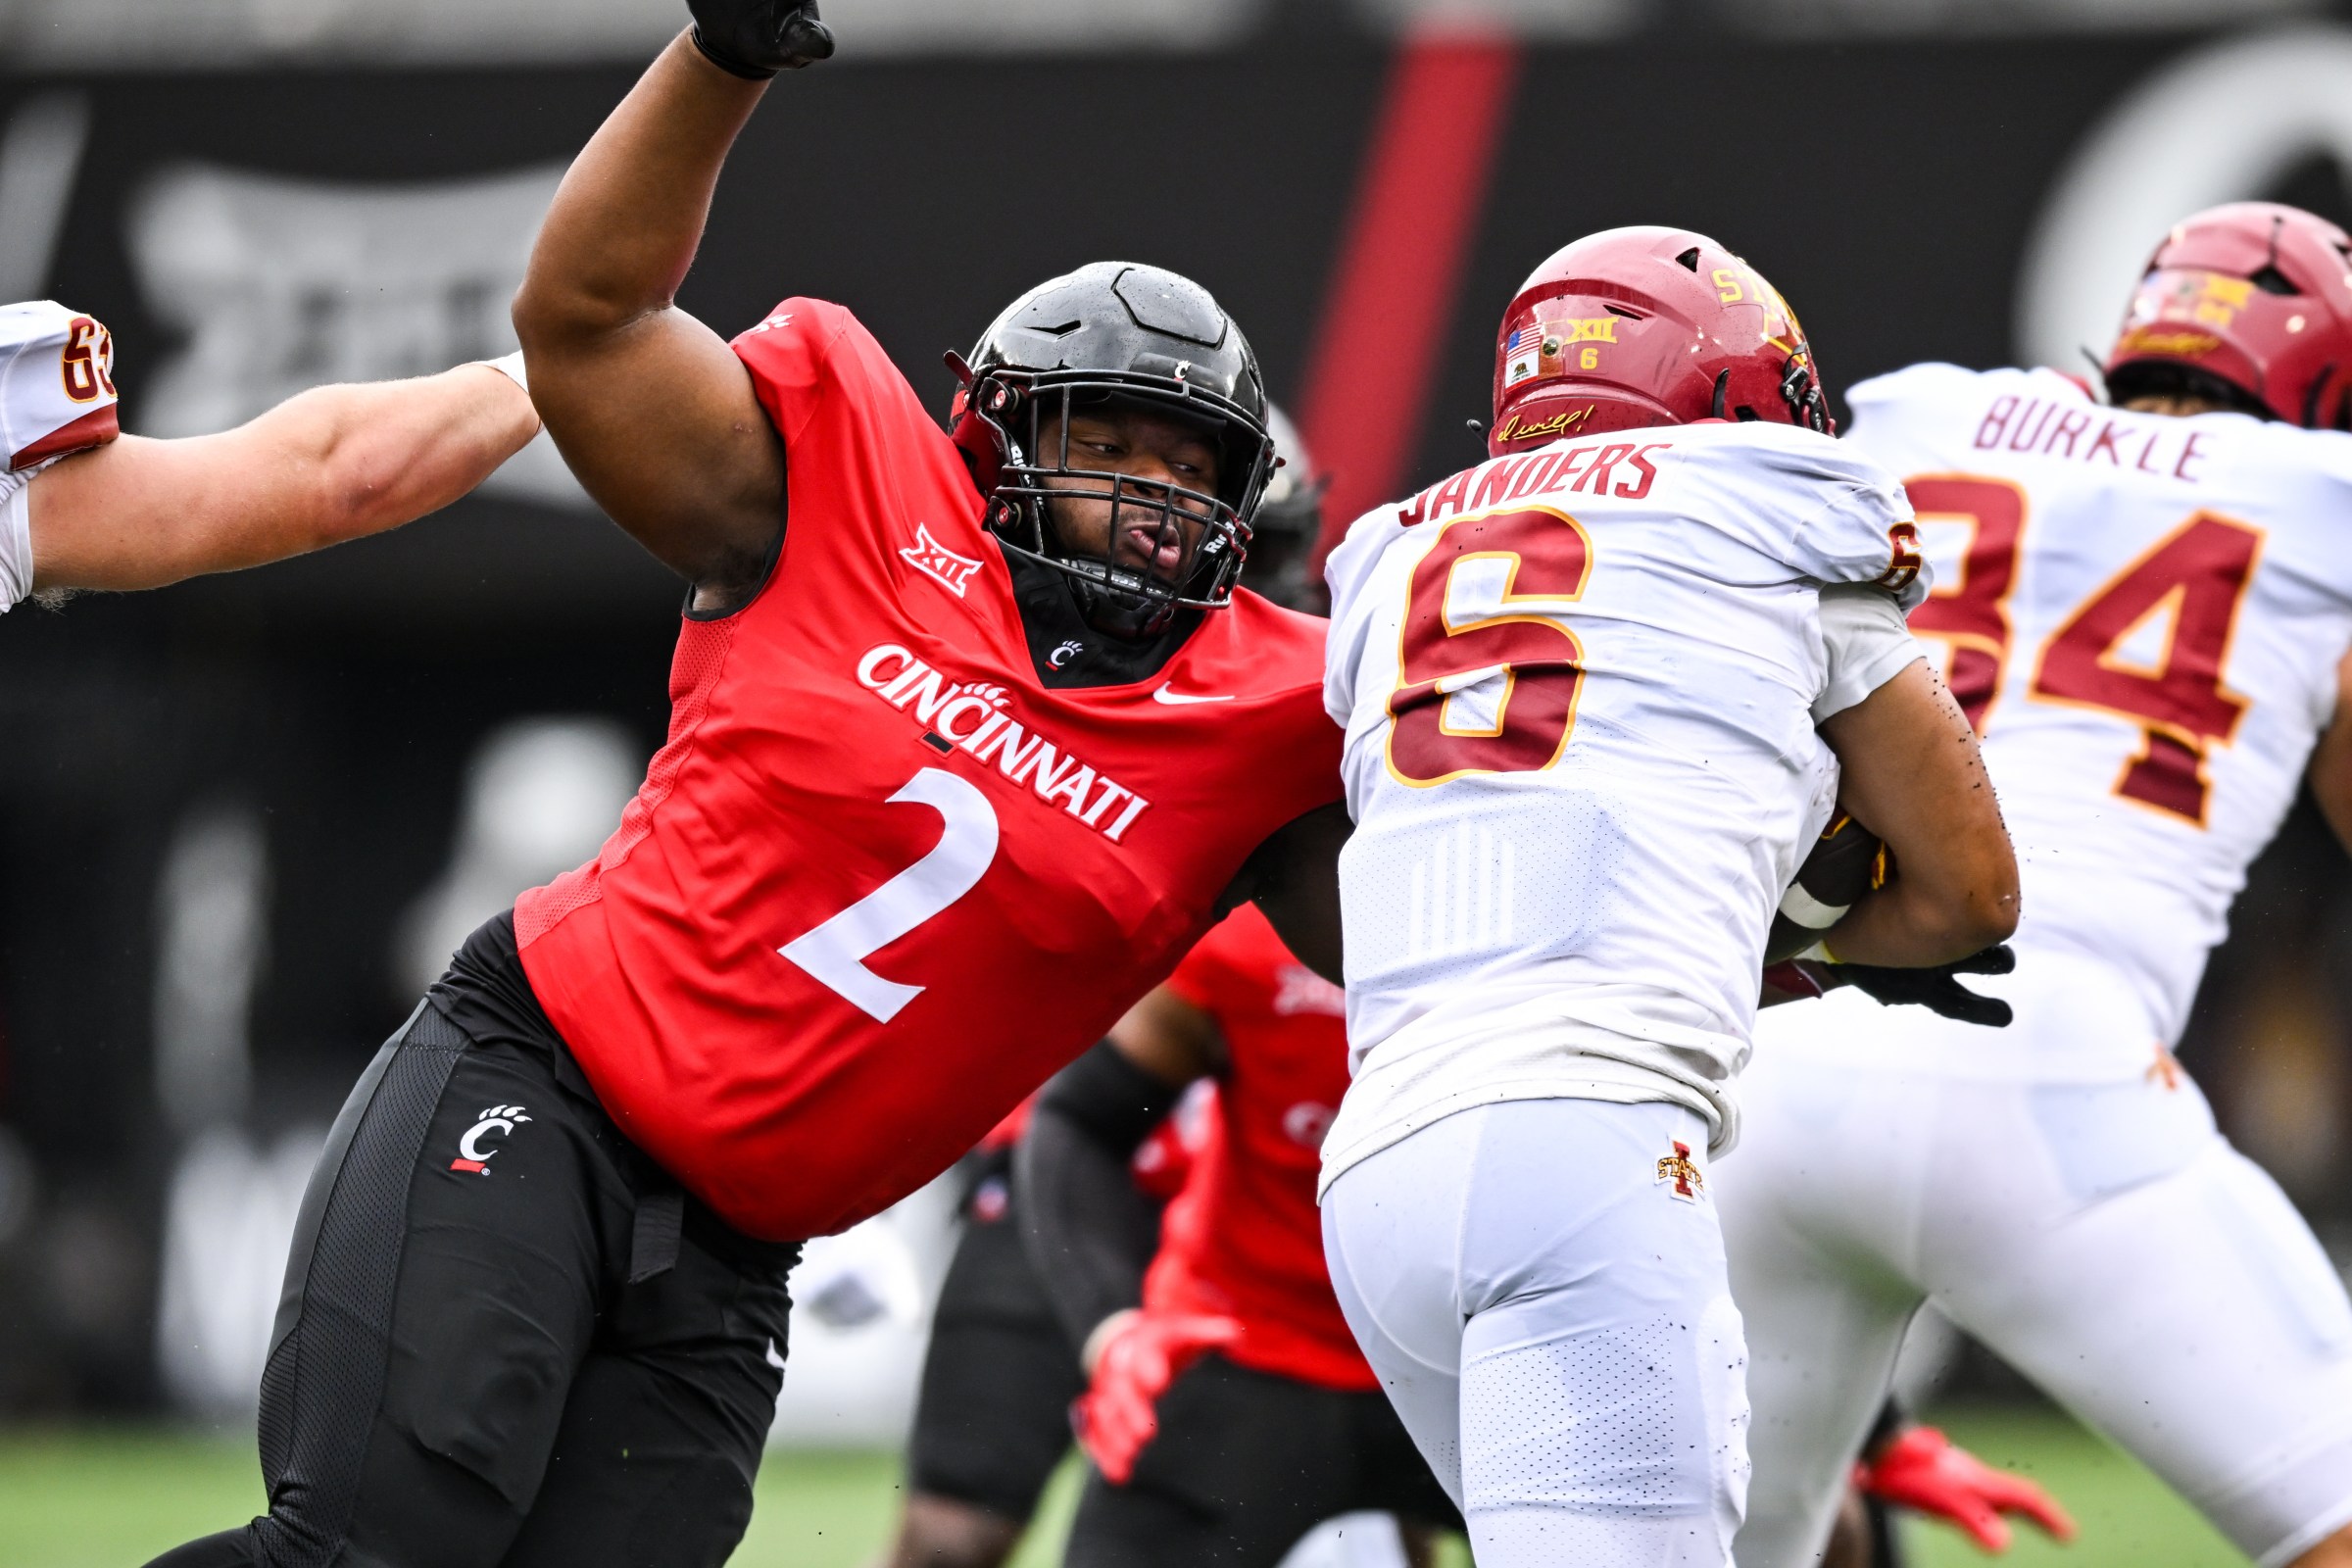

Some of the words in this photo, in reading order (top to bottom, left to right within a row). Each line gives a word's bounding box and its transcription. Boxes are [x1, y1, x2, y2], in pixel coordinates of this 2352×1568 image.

[1562, 317, 1620, 345] XII
[1580, 348, 1598, 369] 6
[1974, 395, 2216, 484] BURKLE
[898, 521, 985, 599] XII
[1874, 520, 1923, 594] 6
[1385, 505, 1594, 789] 6
[858, 643, 1149, 842] CINCINNATI
[777, 767, 999, 1024] 2
[460, 1104, 532, 1161] C
[1657, 1156, 1704, 1193] STATE
